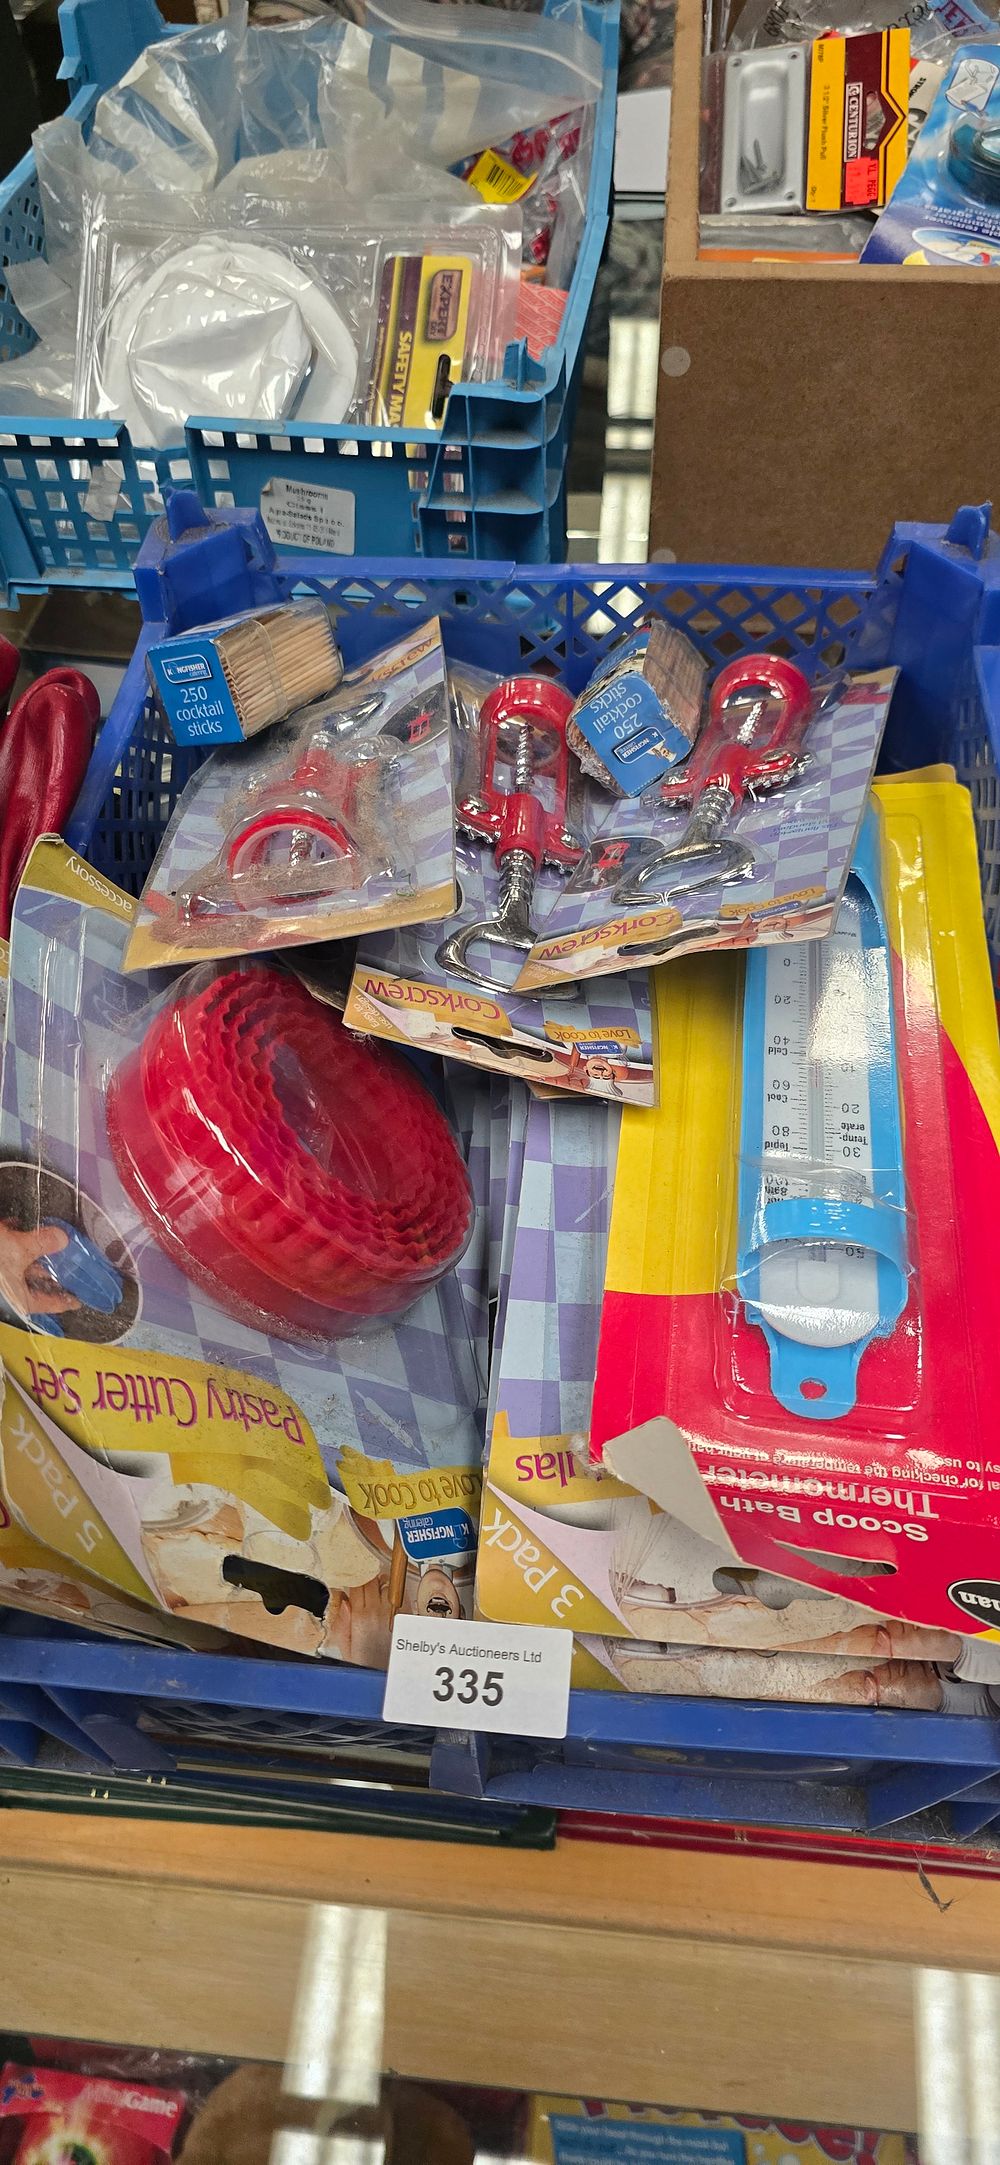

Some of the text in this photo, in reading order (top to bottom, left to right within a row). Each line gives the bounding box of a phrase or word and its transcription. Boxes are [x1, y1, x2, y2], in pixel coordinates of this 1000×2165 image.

[822, 105, 830, 125] Silver
[821, 126, 829, 144] Flush
[847, 97, 859, 158] CENTURION
[820, 146, 828, 160] Pull
[438, 274, 454, 337] EXPERT
[389, 331, 412, 427] SAFETY MA
[286, 484, 328, 500] Mushrooms
[180, 686, 208, 704] 250
[589, 682, 627, 713] sticks
[176, 700, 224, 722] cocktail
[593, 693, 642, 734] cocktail
[188, 719, 223, 737] sticks
[614, 713, 643, 739] 250
[622, 731, 659, 758] KNGFISHER
[65, 856, 132, 912] accessory
[783, 888, 816, 901] Love
[729, 903, 765, 916] Cook
[538, 912, 676, 960] Corkscrew
[364, 979, 500, 1020] Corkscrew
[775, 995, 791, 1005] 20
[556, 1029, 631, 1041] Love to Cook
[773, 1035, 790, 1046] 40
[768, 1047, 788, 1056] Cold
[773, 1080, 790, 1090] 60
[767, 1093, 788, 1103] Cool
[841, 1103, 860, 1114] 20
[772, 1125, 790, 1137] 80
[764, 1139, 790, 1152] Tepid
[842, 1146, 861, 1158] 30
[24, 1356, 306, 1446] Pastry Cutter Set
[864, 1462, 888, 1479] the
[892, 1465, 959, 1487] checking
[966, 1460, 981, 1473] to
[8, 1414, 103, 1553] 5 Pack
[418, 1478, 441, 1506] to
[708, 1465, 940, 1519] Thermometer
[958, 1477, 984, 1491] for
[358, 1482, 417, 1516] Cook
[720, 1496, 929, 1542] Scoop Bath
[482, 1507, 585, 1619] 3 Pack
[396, 1638, 542, 1663] Shelby's Auctioneers Ltd
[433, 1666, 505, 1707] 335
